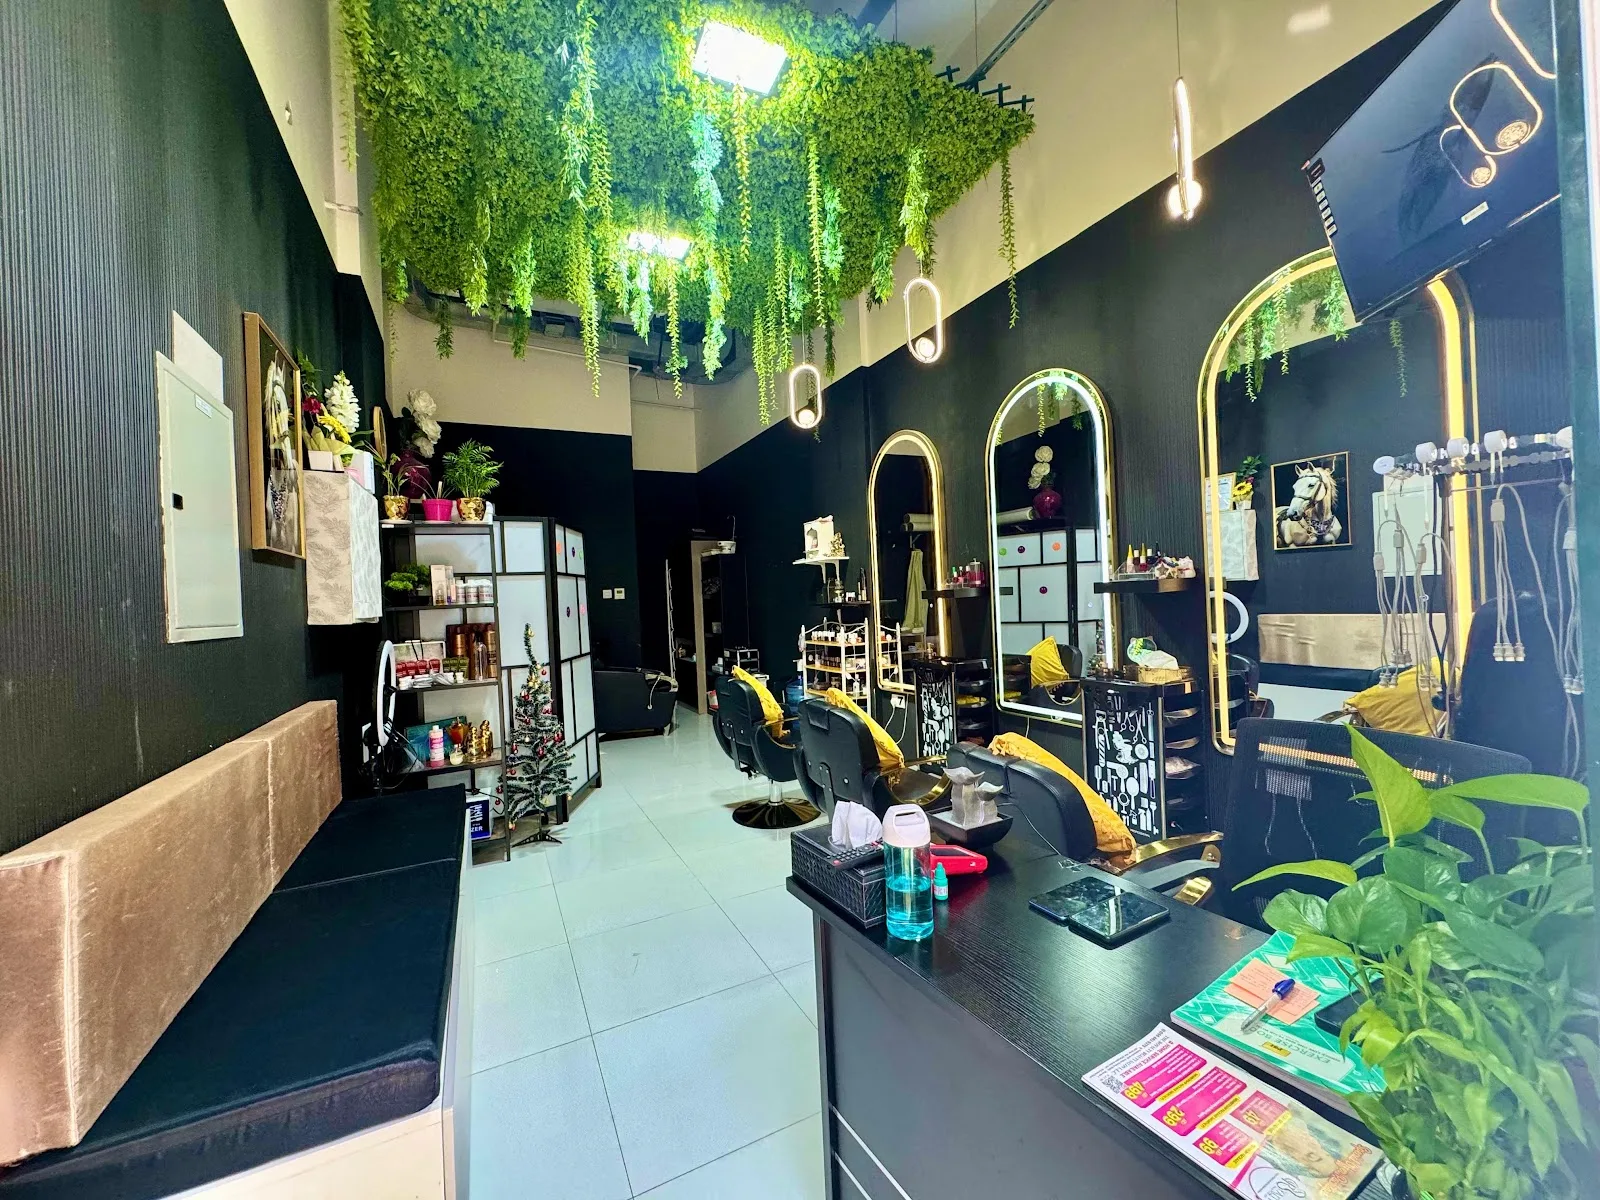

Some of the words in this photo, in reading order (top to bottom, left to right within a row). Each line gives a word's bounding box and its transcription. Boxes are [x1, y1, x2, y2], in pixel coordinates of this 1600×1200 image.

[1156, 1043, 1171, 1053] HOME
[1273, 1038, 1331, 1064] EXERCISE
[1140, 1051, 1159, 1064] SERVICE
[1119, 1061, 1143, 1079] AVAILABLE
[1124, 1081, 1146, 1101] 499
[1162, 1106, 1185, 1128] 299
[1243, 1111, 1260, 1125] 49
[1199, 1137, 1219, 1155] 99
